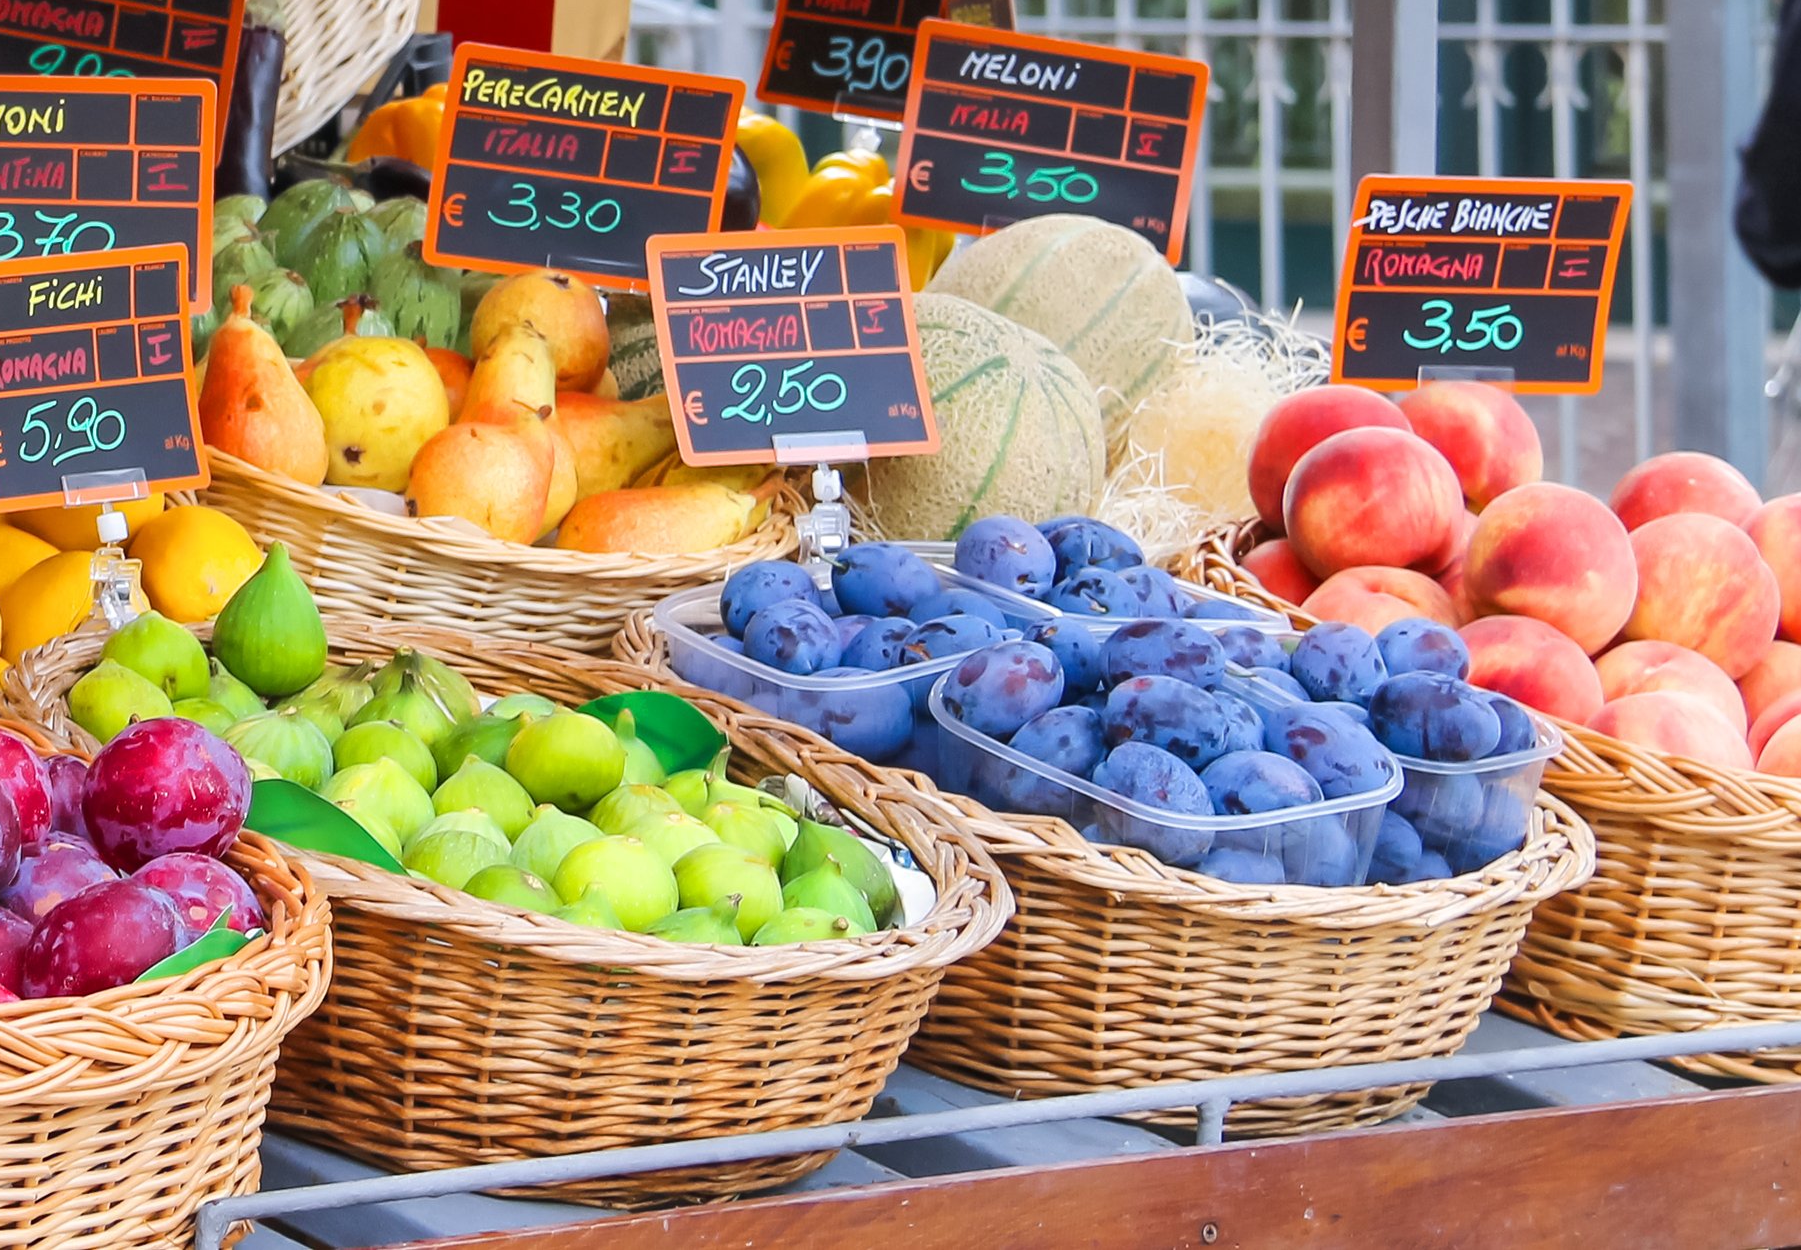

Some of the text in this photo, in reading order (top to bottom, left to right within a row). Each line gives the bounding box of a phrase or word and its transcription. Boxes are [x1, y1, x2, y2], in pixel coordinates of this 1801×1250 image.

[775, 35, 911, 94] € 3,90
[909, 160, 934, 193] €
[960, 151, 1099, 204] 3,50
[442, 182, 621, 233] € 3,30
[1353, 197, 1449, 234] PESCHE
[678, 249, 824, 296] STANLEY
[1364, 248, 1484, 287] ROMAGNA
[688, 314, 798, 353] ROMAGNA
[1347, 316, 1369, 352] €
[1403, 299, 1524, 354] 3,50
[684, 390, 709, 425] €
[721, 360, 847, 426] 2,50
[888, 404, 899, 418] al
[18, 396, 127, 466] 5,90
[164, 438, 175, 451] al
